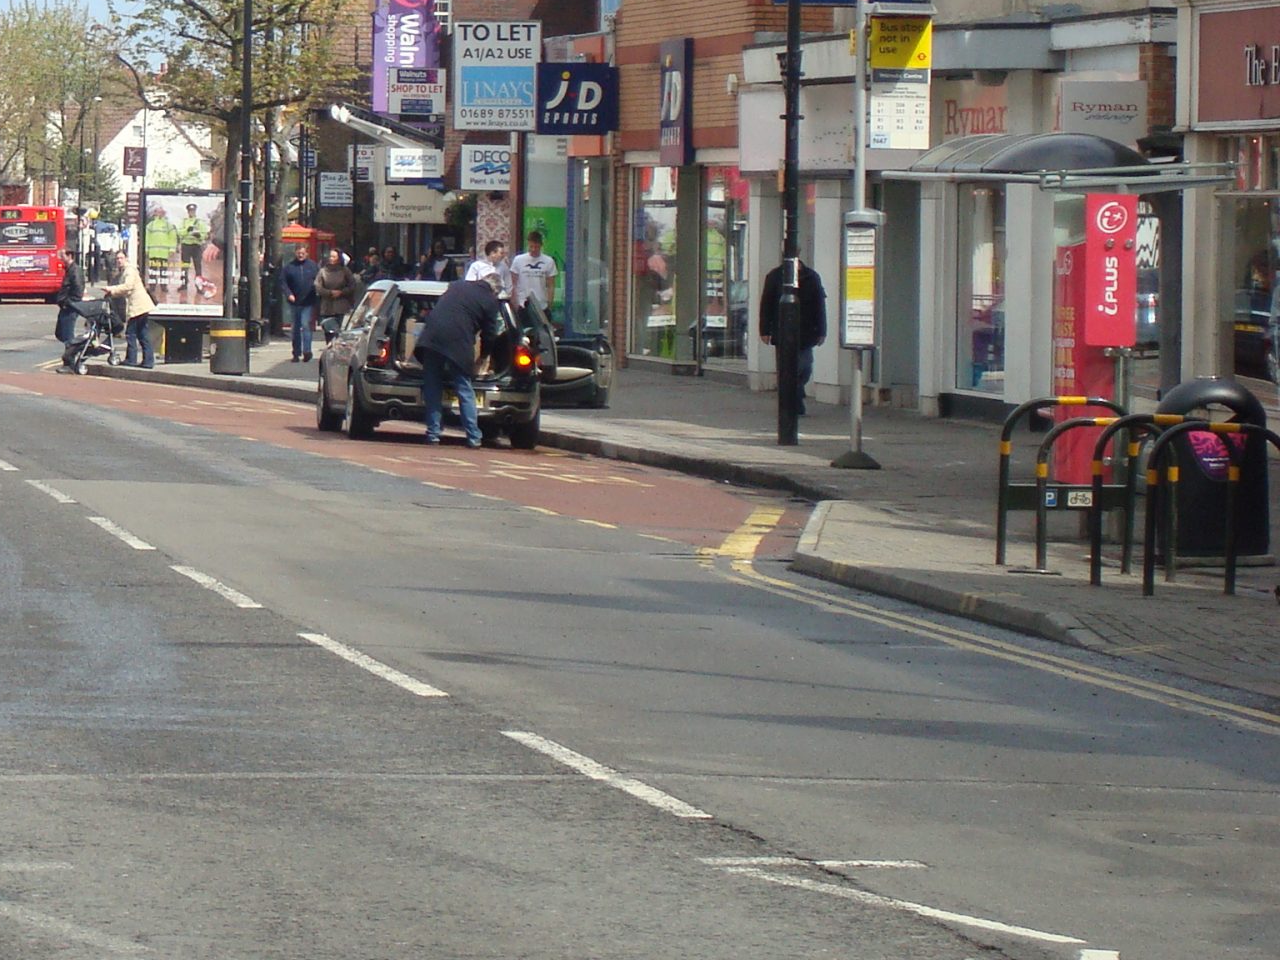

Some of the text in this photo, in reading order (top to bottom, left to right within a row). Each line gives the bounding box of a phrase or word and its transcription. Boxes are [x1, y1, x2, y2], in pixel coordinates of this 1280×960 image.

[458, 24, 537, 41] TO LET
[880, 22, 923, 35] Bus stop
[384, 13, 399, 63] shopping
[880, 34, 910, 43] not in
[463, 47, 533, 62] A1/A2 USE
[879, 46, 897, 54] use
[1244, 43, 1266, 86] The
[391, 84, 443, 93] SHOP TO LET
[462, 80, 533, 105] LINAYS
[460, 109, 535, 119] 01689 875511
[1072, 102, 1139, 114] Ryman
[544, 112, 598, 124] SPORTS
